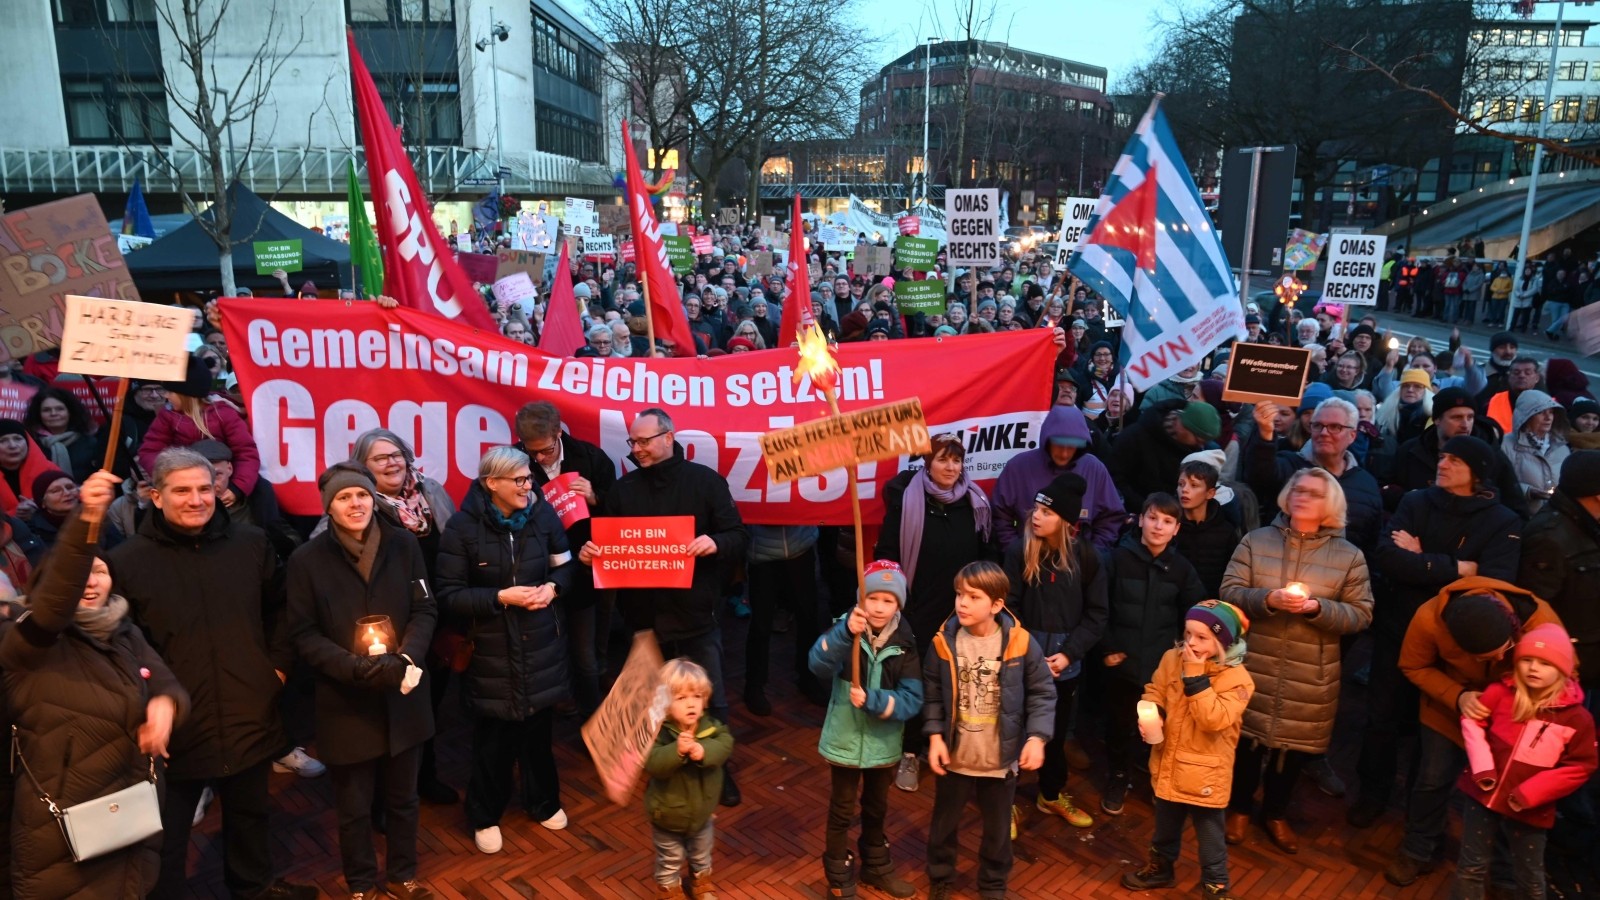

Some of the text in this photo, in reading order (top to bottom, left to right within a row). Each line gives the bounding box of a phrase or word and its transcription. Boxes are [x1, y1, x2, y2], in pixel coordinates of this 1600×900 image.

[954, 194, 988, 212] OMAS
[1073, 203, 1095, 220] OMA
[720, 208, 738, 224] NO
[951, 218, 992, 236] GEGEN
[585, 241, 612, 252] RECHTS
[897, 248, 936, 257] VERFASSUNGS-
[949, 242, 997, 259] RECHTS
[1340, 239, 1376, 256] OMAS
[256, 251, 302, 260] VERFASSUNGS-
[261, 259, 299, 267] SCHÜTZER:IN
[898, 256, 932, 264] SCHÜTZER:IN
[2, 233, 122, 296] BÖCKE
[1333, 260, 1376, 277] GEGEN
[897, 292, 944, 300] VERFASSUNGS-
[1326, 282, 1375, 300] RECHTS
[247, 318, 528, 388] Gemeinsam
[1130, 334, 1194, 379] VVN
[1240, 358, 1299, 370] #WeRemember
[251, 378, 569, 488] Gege
[764, 432, 805, 456] EURE
[893, 400, 923, 423] UNS
[774, 455, 805, 481] AN!
[806, 436, 854, 469] NEIN
[855, 430, 888, 457] ZUR
[888, 423, 928, 453] AfD
[620, 528, 667, 539] ICH BIN
[603, 559, 685, 570] SCHÜTZER:IN
